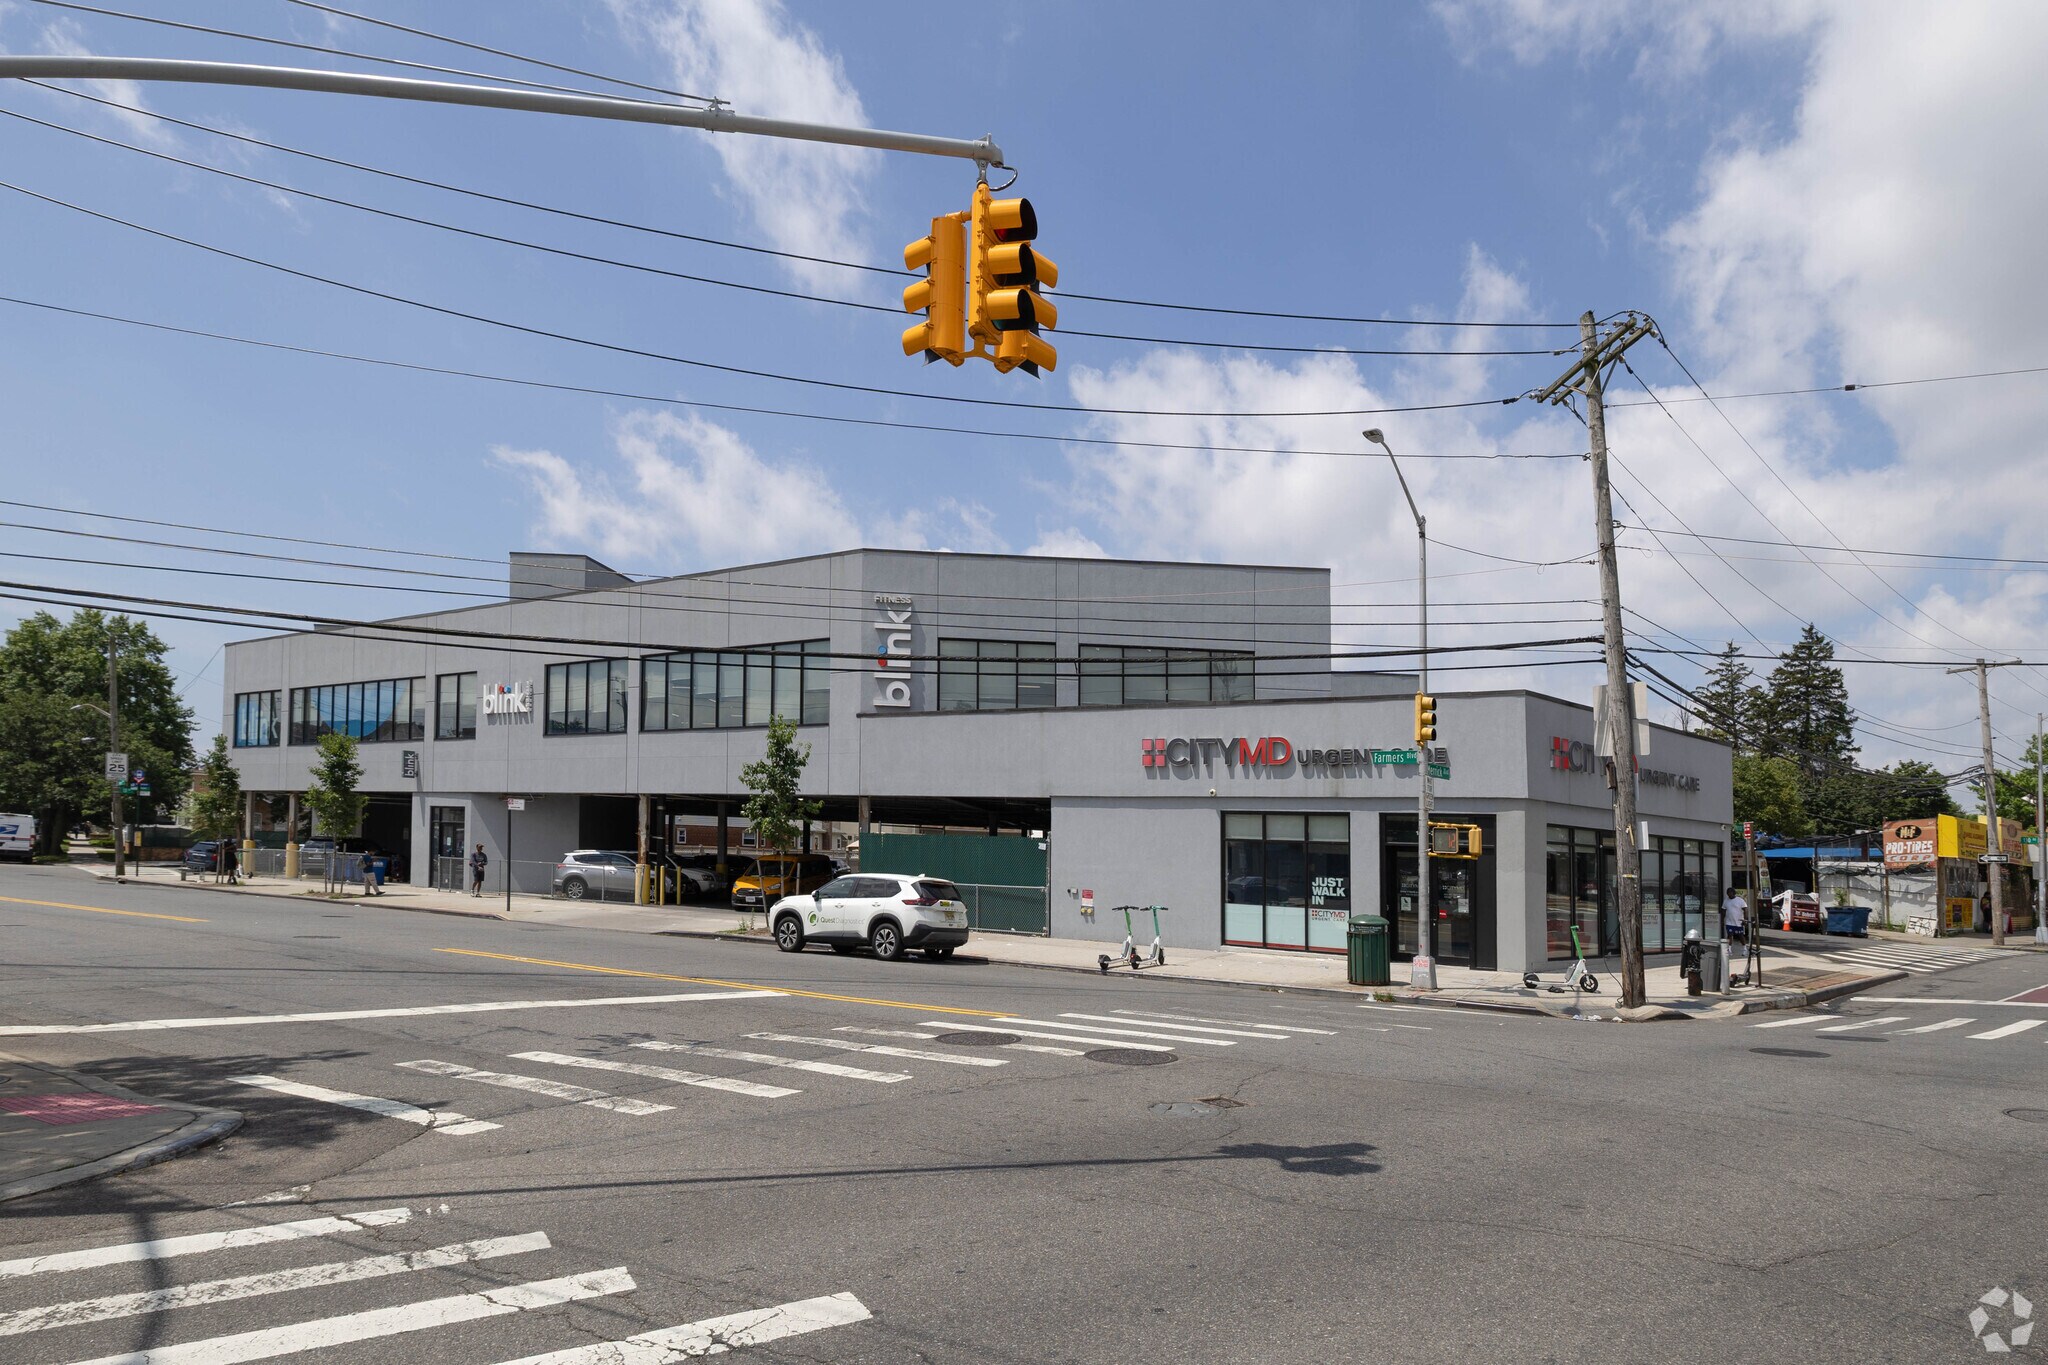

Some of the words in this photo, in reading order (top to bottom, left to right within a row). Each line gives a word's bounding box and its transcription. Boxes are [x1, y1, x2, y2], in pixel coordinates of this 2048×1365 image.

[874, 595, 912, 604] FITNESS
[873, 606, 911, 707] blink
[483, 682, 528, 714] blink
[1166, 738, 1292, 766] CITYMD
[1297, 749, 1382, 766] URGEN
[1374, 753, 1404, 763] Farmers
[1406, 752, 1418, 760] Blvd
[109, 764, 125, 773] 25
[404, 753, 415, 777] blink
[1640, 768, 1677, 788] URGENT
[1679, 775, 1701, 792] CARE
[1312, 877, 1344, 887] JUST
[1312, 886, 1346, 897] WALK
[1312, 896, 1325, 905] IN
[1317, 910, 1346, 918] CITYMD
[820, 916, 836, 924] Quest
